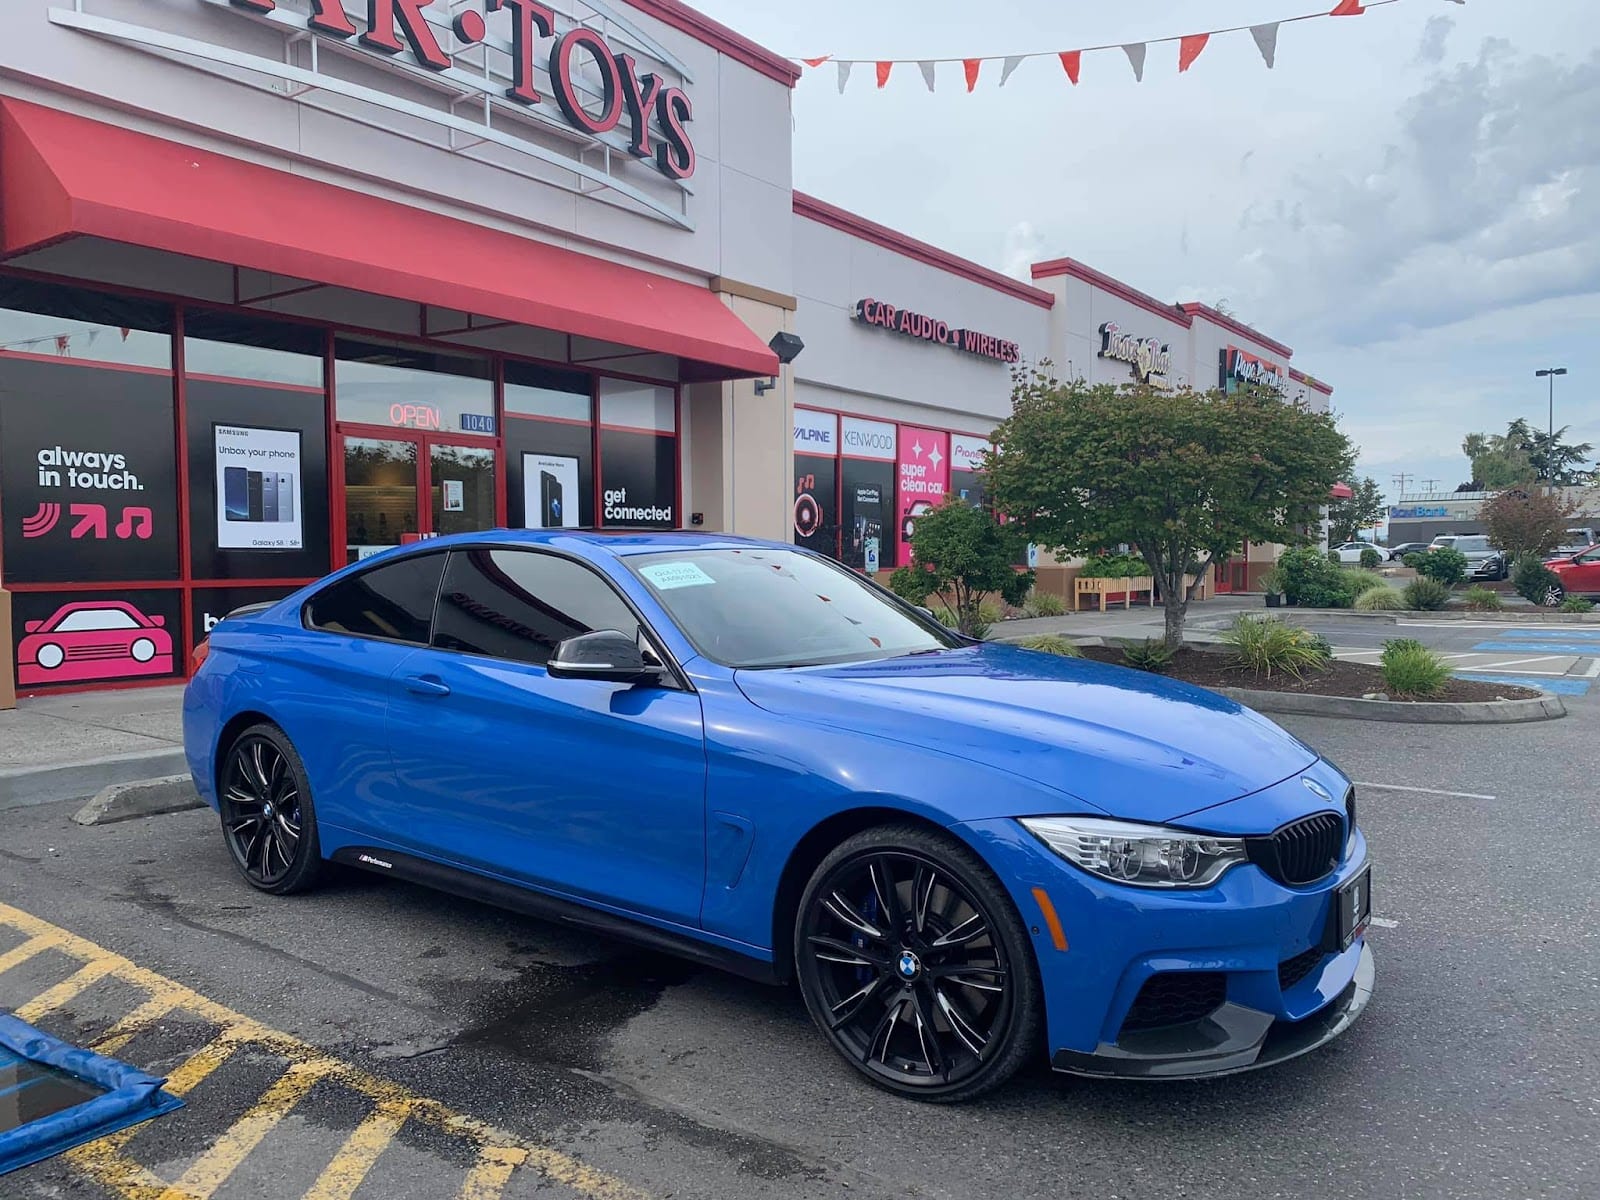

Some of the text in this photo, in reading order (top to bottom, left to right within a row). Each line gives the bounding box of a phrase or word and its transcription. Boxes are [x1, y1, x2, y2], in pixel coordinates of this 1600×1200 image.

[486, 0, 694, 179] TOYS
[861, 298, 1020, 363] CAR AUDIO WIRELESS
[1103, 322, 1140, 363] Taste
[390, 402, 440, 428] OPEN
[466, 414, 493, 432] 1040
[218, 428, 249, 437] SAMSUNG
[795, 426, 831, 443] ALPINE
[844, 430, 893, 450] KENWOOD
[37, 446, 126, 473] always
[218, 446, 295, 459] Unbox your phone
[38, 466, 144, 490] in touch.
[901, 463, 927, 478] super
[901, 476, 945, 494] clean car.
[604, 487, 626, 507] get
[604, 505, 671, 521] connected
[252, 539, 275, 547] Galaxy
